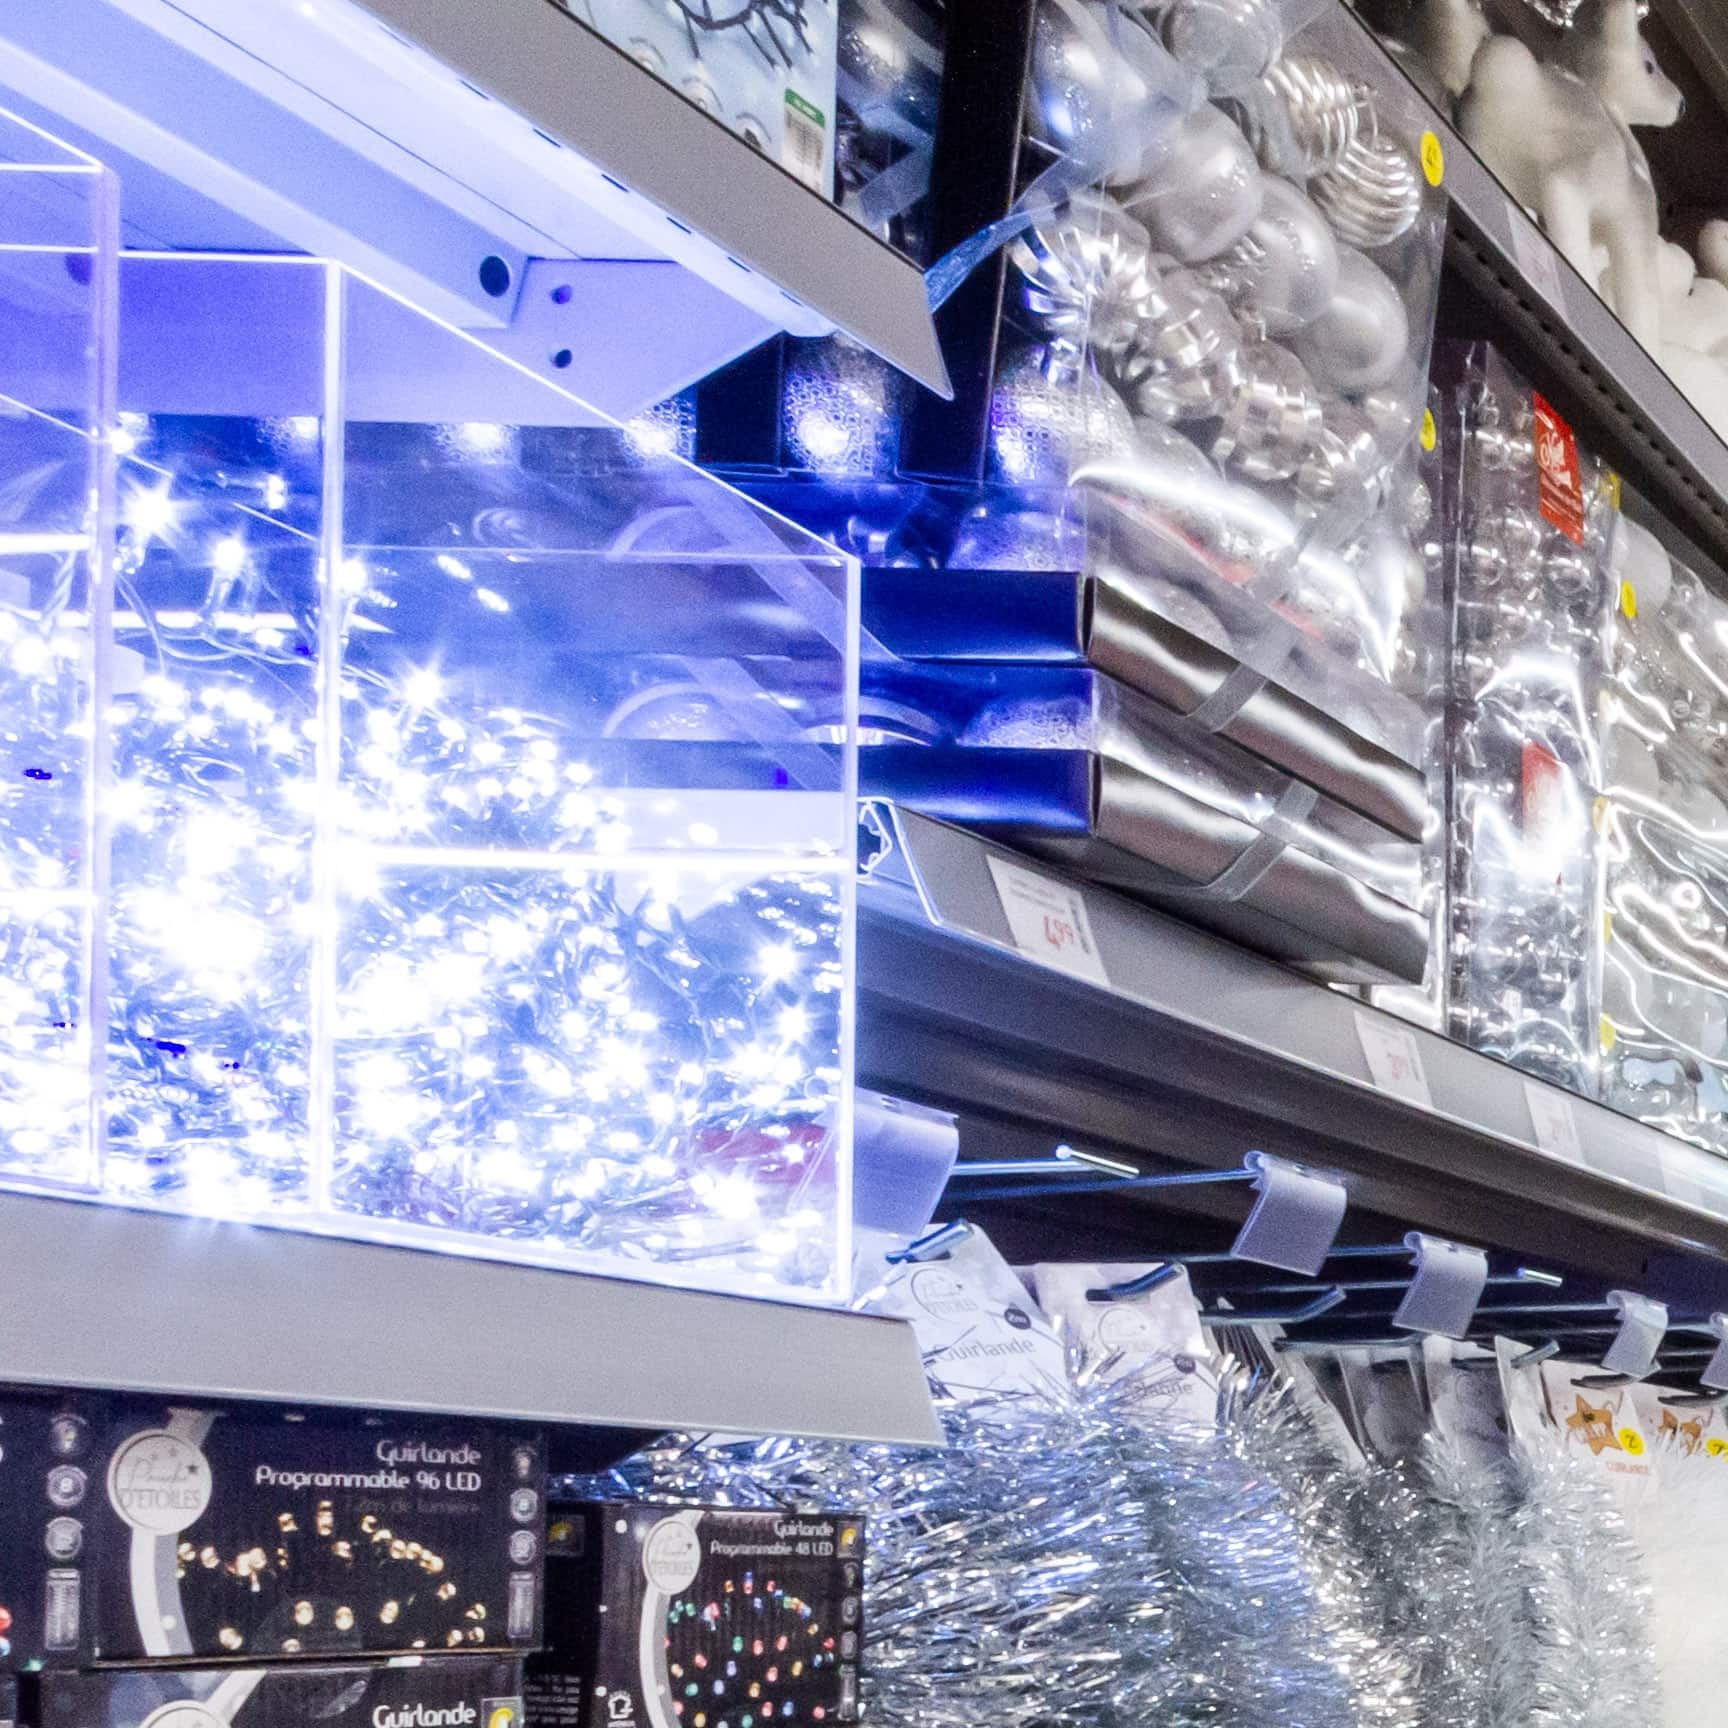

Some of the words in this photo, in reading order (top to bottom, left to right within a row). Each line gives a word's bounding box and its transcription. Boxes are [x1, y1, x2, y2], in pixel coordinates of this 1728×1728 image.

[375, 1440, 482, 1466] Guirlande
[255, 1465, 410, 1491] Programmable
[415, 1466, 440, 1490] 96
[445, 1471, 482, 1491] LED
[773, 1519, 834, 1539] Guirlande
[709, 1539, 794, 1558] Programmable
[812, 1541, 834, 1557] LED
